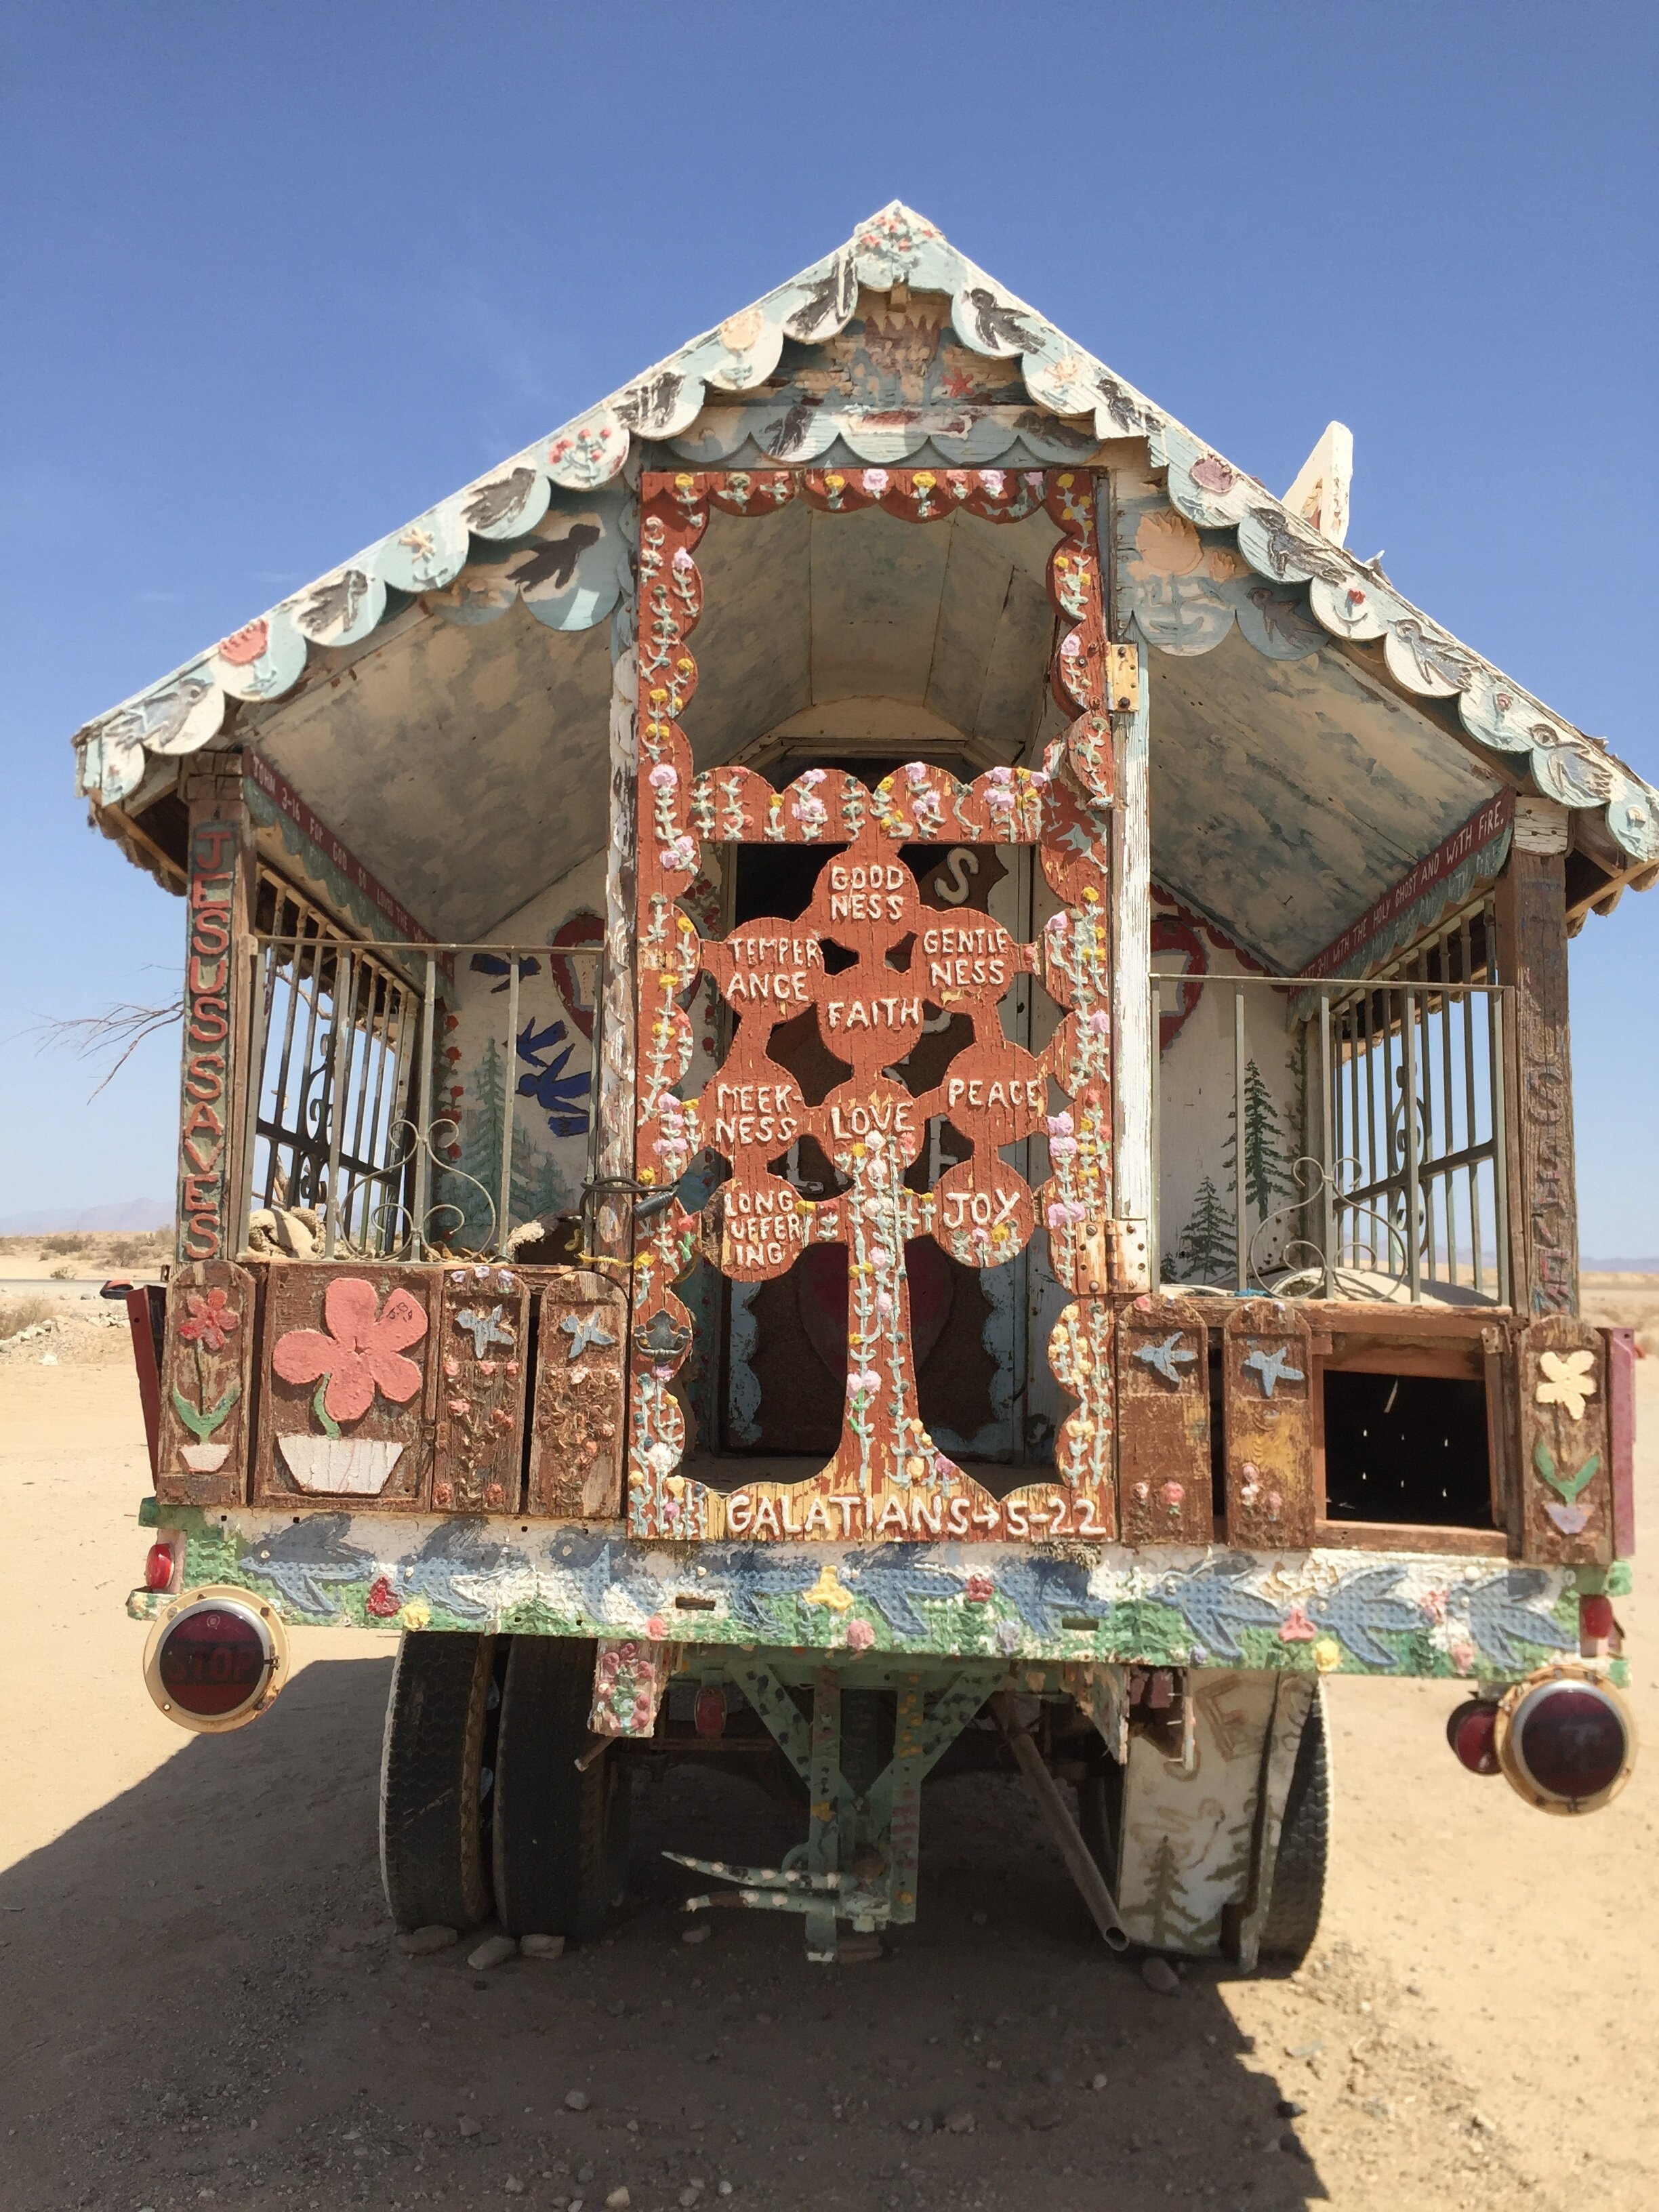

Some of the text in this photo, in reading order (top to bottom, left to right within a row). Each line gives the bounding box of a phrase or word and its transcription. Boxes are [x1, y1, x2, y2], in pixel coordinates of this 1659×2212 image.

[282, 787, 300, 822] 3-16
[333, 842, 347, 871] GOD
[831, 865, 903, 891] GOOD
[831, 894, 904, 921] NESS
[1333, 935, 1349, 963] WITH
[1353, 918, 1368, 946] THE
[1373, 899, 1391, 929] HOLY
[1395, 871, 1418, 908] GHOST
[1420, 853, 1439, 885] AND
[727, 937, 823, 967] TEMPER
[924, 928, 1008, 954] GENTLE
[725, 971, 809, 1002] ANCE
[930, 959, 1004, 989] NESS
[827, 997, 920, 1028] FAITH
[184, 830, 233, 1261] JESUS SAVES
[949, 1078, 1041, 1109] PEACE
[715, 1116, 798, 1145] NESS
[831, 1101, 916, 1140] LOVE
[724, 1190, 794, 1217] LONG
[943, 1189, 1021, 1229] JOY
[735, 1242, 783, 1267] ING
[727, 1495, 1107, 1536] GALATIANS 5-22
